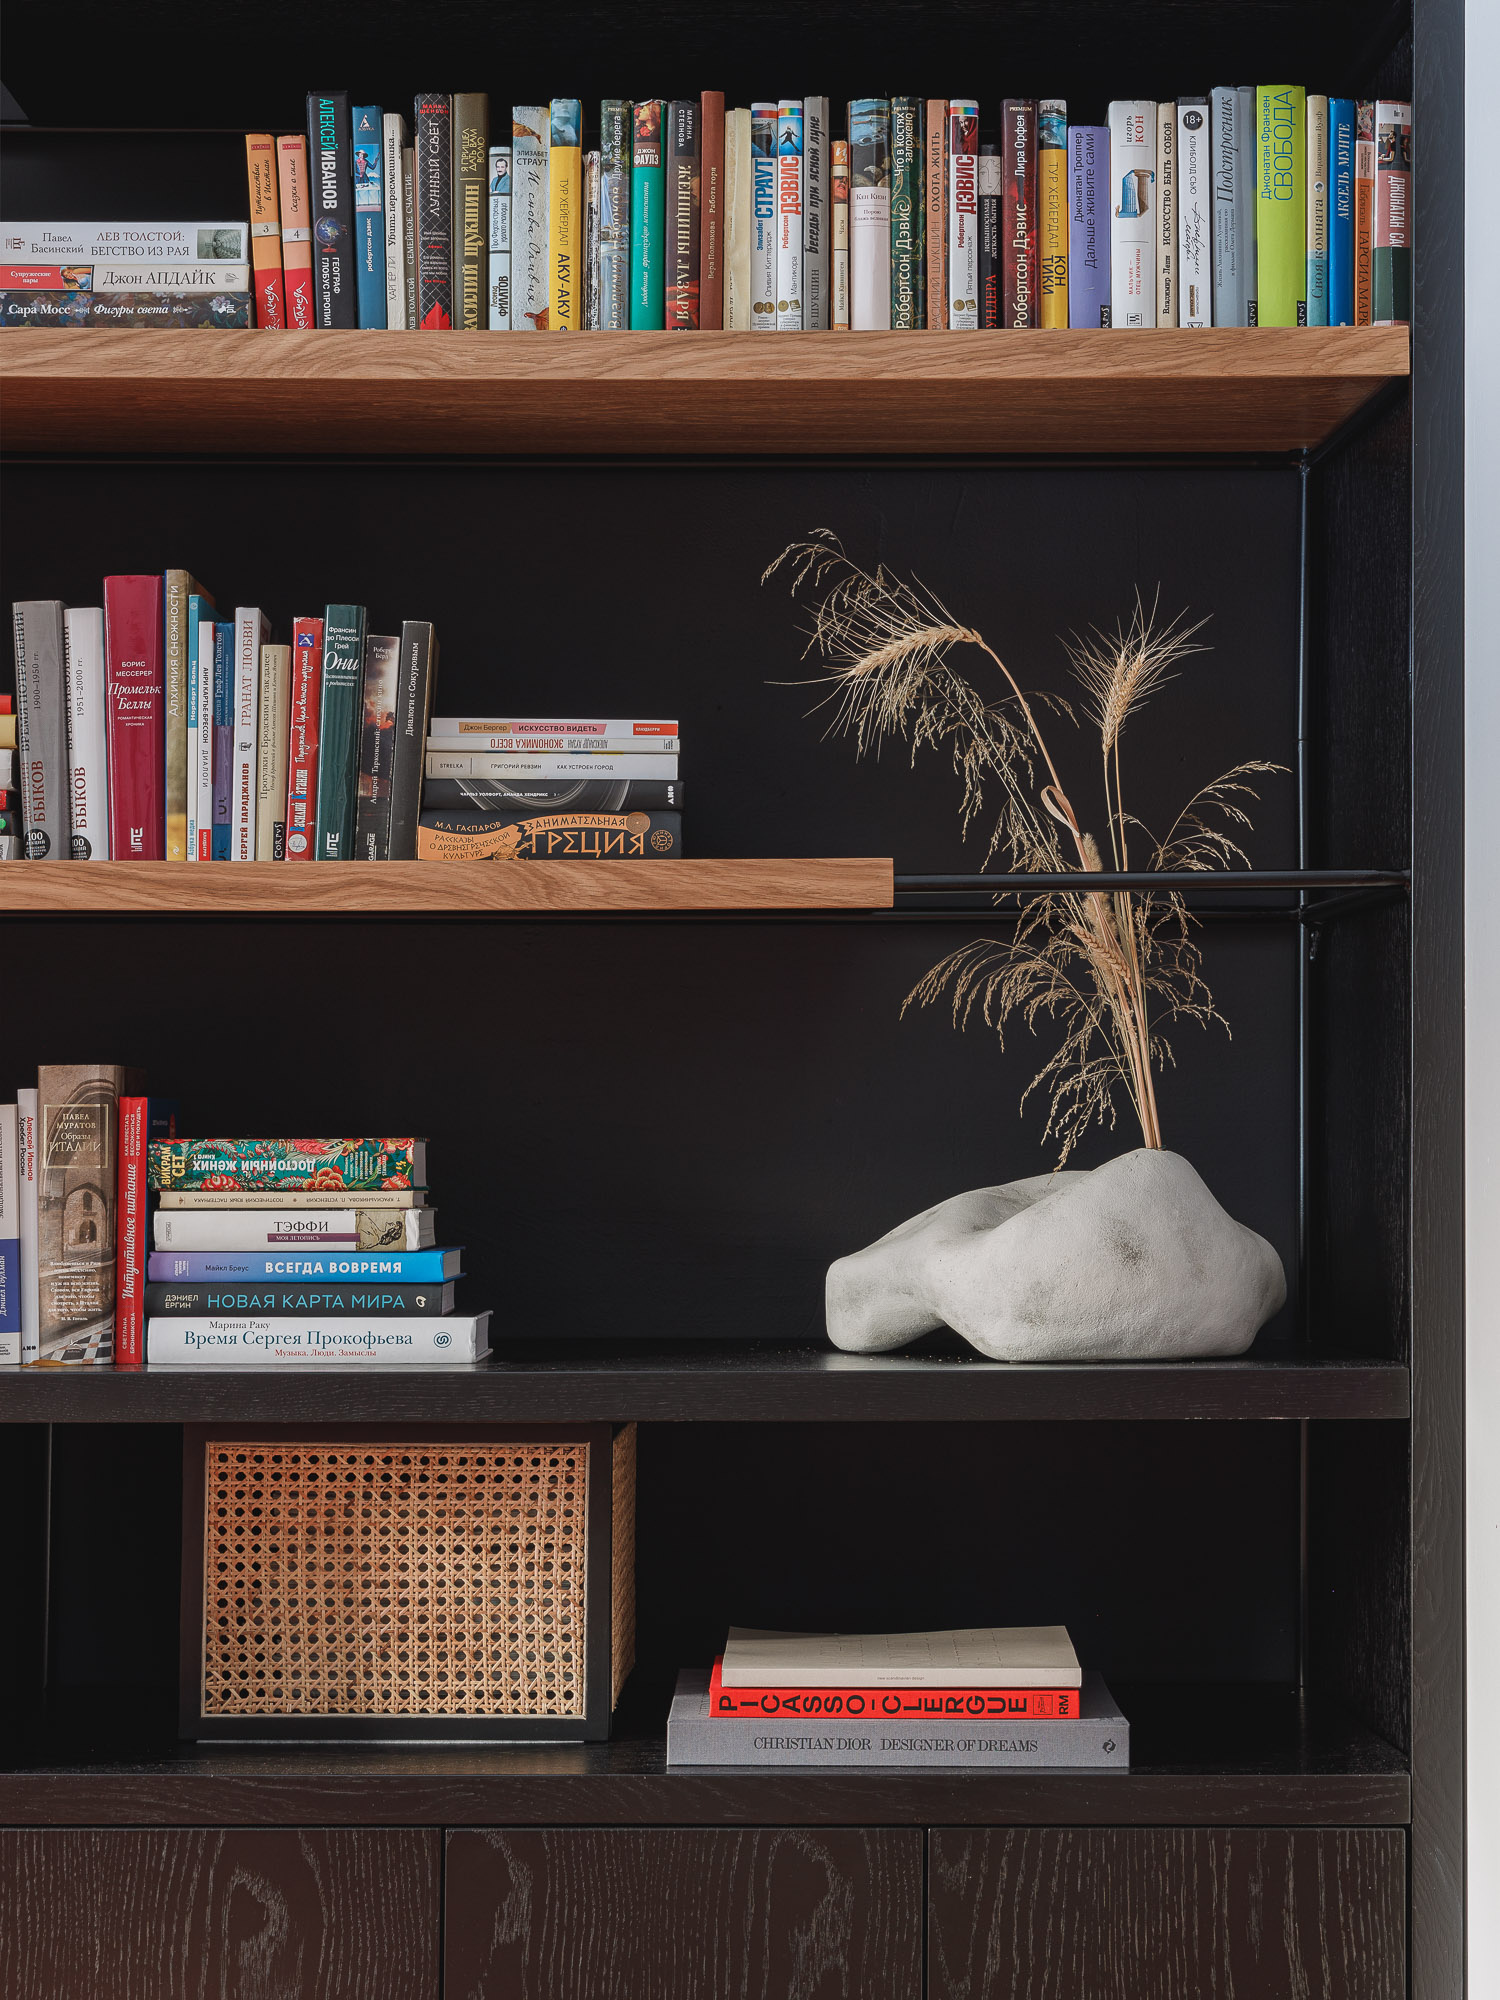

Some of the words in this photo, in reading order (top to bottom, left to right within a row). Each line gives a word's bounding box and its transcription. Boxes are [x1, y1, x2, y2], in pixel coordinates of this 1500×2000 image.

[320, 98, 338, 150] АЛЕКСЕЙ
[428, 120, 440, 154] СВЕТ
[1135, 115, 1144, 143] КОН
[1185, 115, 1202, 124] 18+
[1260, 95, 1270, 142] Франзен
[460, 128, 470, 166] ПРИШЕЛ
[904, 112, 914, 164] заложено
[930, 132, 940, 168] ЖИТЬ
[1074, 132, 1084, 173] Троппер
[1086, 134, 1096, 166] сами
[1216, 96, 1238, 204] Подстрочник
[1274, 90, 1296, 200] СВОБОДА
[322, 150, 338, 210] ИВАНОВ
[516, 159, 548, 167] СТРАУТ
[1260, 145, 1272, 200] Джонатан
[404, 174, 414, 214] СЧАСТИЕ
[428, 160, 440, 217] ЛУННЫЙ
[560, 178, 568, 195] ТУР
[708, 186, 716, 214] Работа
[754, 159, 774, 218] СТРАУТ
[780, 156, 802, 215] ДЭВИС
[930, 172, 940, 212] ОХОТА
[956, 156, 976, 214] ДЭВИС
[1074, 175, 1084, 223] Джонатан
[1086, 168, 1096, 216] живите
[558, 196, 570, 246] ХЕЙЕРДАЛ
[608, 187, 622, 250] Набоков
[676, 164, 692, 254] ЖЕНЩИНЫ
[896, 204, 912, 250] Дэвис
[1012, 204, 1029, 250] Дэвис
[42, 232, 72, 242] Павел
[263, 225, 270, 233] 3
[294, 230, 300, 238] 4
[404, 216, 414, 265] СЕМЕЙНОЕ
[708, 222, 716, 260] Полозкова
[782, 216, 790, 249] Робертсон
[1084, 218, 1098, 269] Дальше
[1312, 199, 1324, 260] комната
[30, 244, 84, 254] Басинский
[764, 231, 773, 270] Киттеридж
[102, 271, 143, 286] Джон
[146, 269, 216, 286] АПДАЙК
[322, 257, 331, 290] ГЛОБУС
[332, 257, 340, 294] ГЕОГРАФ
[558, 253, 570, 318] АКУ-АКУ
[676, 258, 690, 320] ЛАЗАРЯ
[708, 262, 716, 279] Вера
[790, 256, 798, 295] Мантикора
[1042, 254, 1054, 295] ТИКИ
[1054, 255, 1066, 286] КОН
[1311, 264, 1323, 299] Своя
[322, 292, 332, 326] ПРОПИЛ
[490, 286, 498, 308] Леонид
[498, 276, 509, 317] ФИЛАТОВ
[608, 255, 625, 329] Владимир
[895, 254, 913, 330] Робертсон
[1012, 254, 1031, 329] Робертсон
[8, 304, 38, 317] Сара
[40, 304, 71, 314] Мосс
[94, 304, 134, 318] Фигуры
[137, 305, 169, 314] света
[170, 585, 179, 656] снежности
[241, 620, 253, 672] ЛЮБВИ
[324, 652, 359, 670] Они
[408, 642, 420, 692] Сокуровым
[108, 682, 162, 698] Промельк
[118, 697, 152, 710] Беллы
[168, 659, 180, 717] Алхимия
[241, 675, 252, 726] ГРАНАТ
[406, 700, 415, 736] Диалоги
[464, 724, 481, 733] Джон
[482, 724, 507, 733] Бергер
[490, 739, 514, 749] ВСЕГО
[516, 739, 564, 749] ЭКОНОМИКА
[31, 760, 46, 822] БЫКОВ
[74, 766, 88, 829] БЫКОВ
[240, 763, 250, 824] ПАРАДЖАНОВ
[292, 769, 308, 800] Катанян
[290, 802, 306, 832] Василий
[526, 816, 624, 834] ЗАНИМАТЕЛЬНАЯ
[239, 826, 249, 860] СЕРГЕЙ
[368, 832, 376, 860] GARAGE
[434, 834, 474, 844] РАССКАЗЫ
[532, 832, 644, 857] ГРЕЦИЯ
[160, 1146, 171, 1185] ВИКРАМ
[126, 1163, 138, 1215] питание
[274, 1221, 328, 1232] ТЭФФИ
[122, 1218, 142, 1300] Интуитивное
[265, 1262, 323, 1276] ВСЕГДА
[329, 1262, 402, 1274] ВОВРЕМЯ
[208, 1294, 276, 1309] НОВАЯ
[282, 1294, 344, 1309] КАРТА
[351, 1294, 405, 1309] МИРА
[184, 1331, 237, 1349] Время
[241, 1331, 302, 1349] Сергея
[307, 1330, 413, 1349] Прокофьева
[209, 1320, 247, 1331] Марина
[249, 1320, 270, 1332] Раку
[275, 1349, 309, 1358] Музыка.
[311, 1350, 336, 1358] Люди.
[338, 1349, 377, 1357] Замыслы
[1059, 1695, 1069, 1715] RM
[753, 1736, 835, 1751] CHRISTIAN
[836, 1736, 872, 1751] DIOR
[881, 1736, 956, 1752] DESIGNER
[957, 1737, 976, 1752] OF
[977, 1737, 1038, 1752] DREAMS
